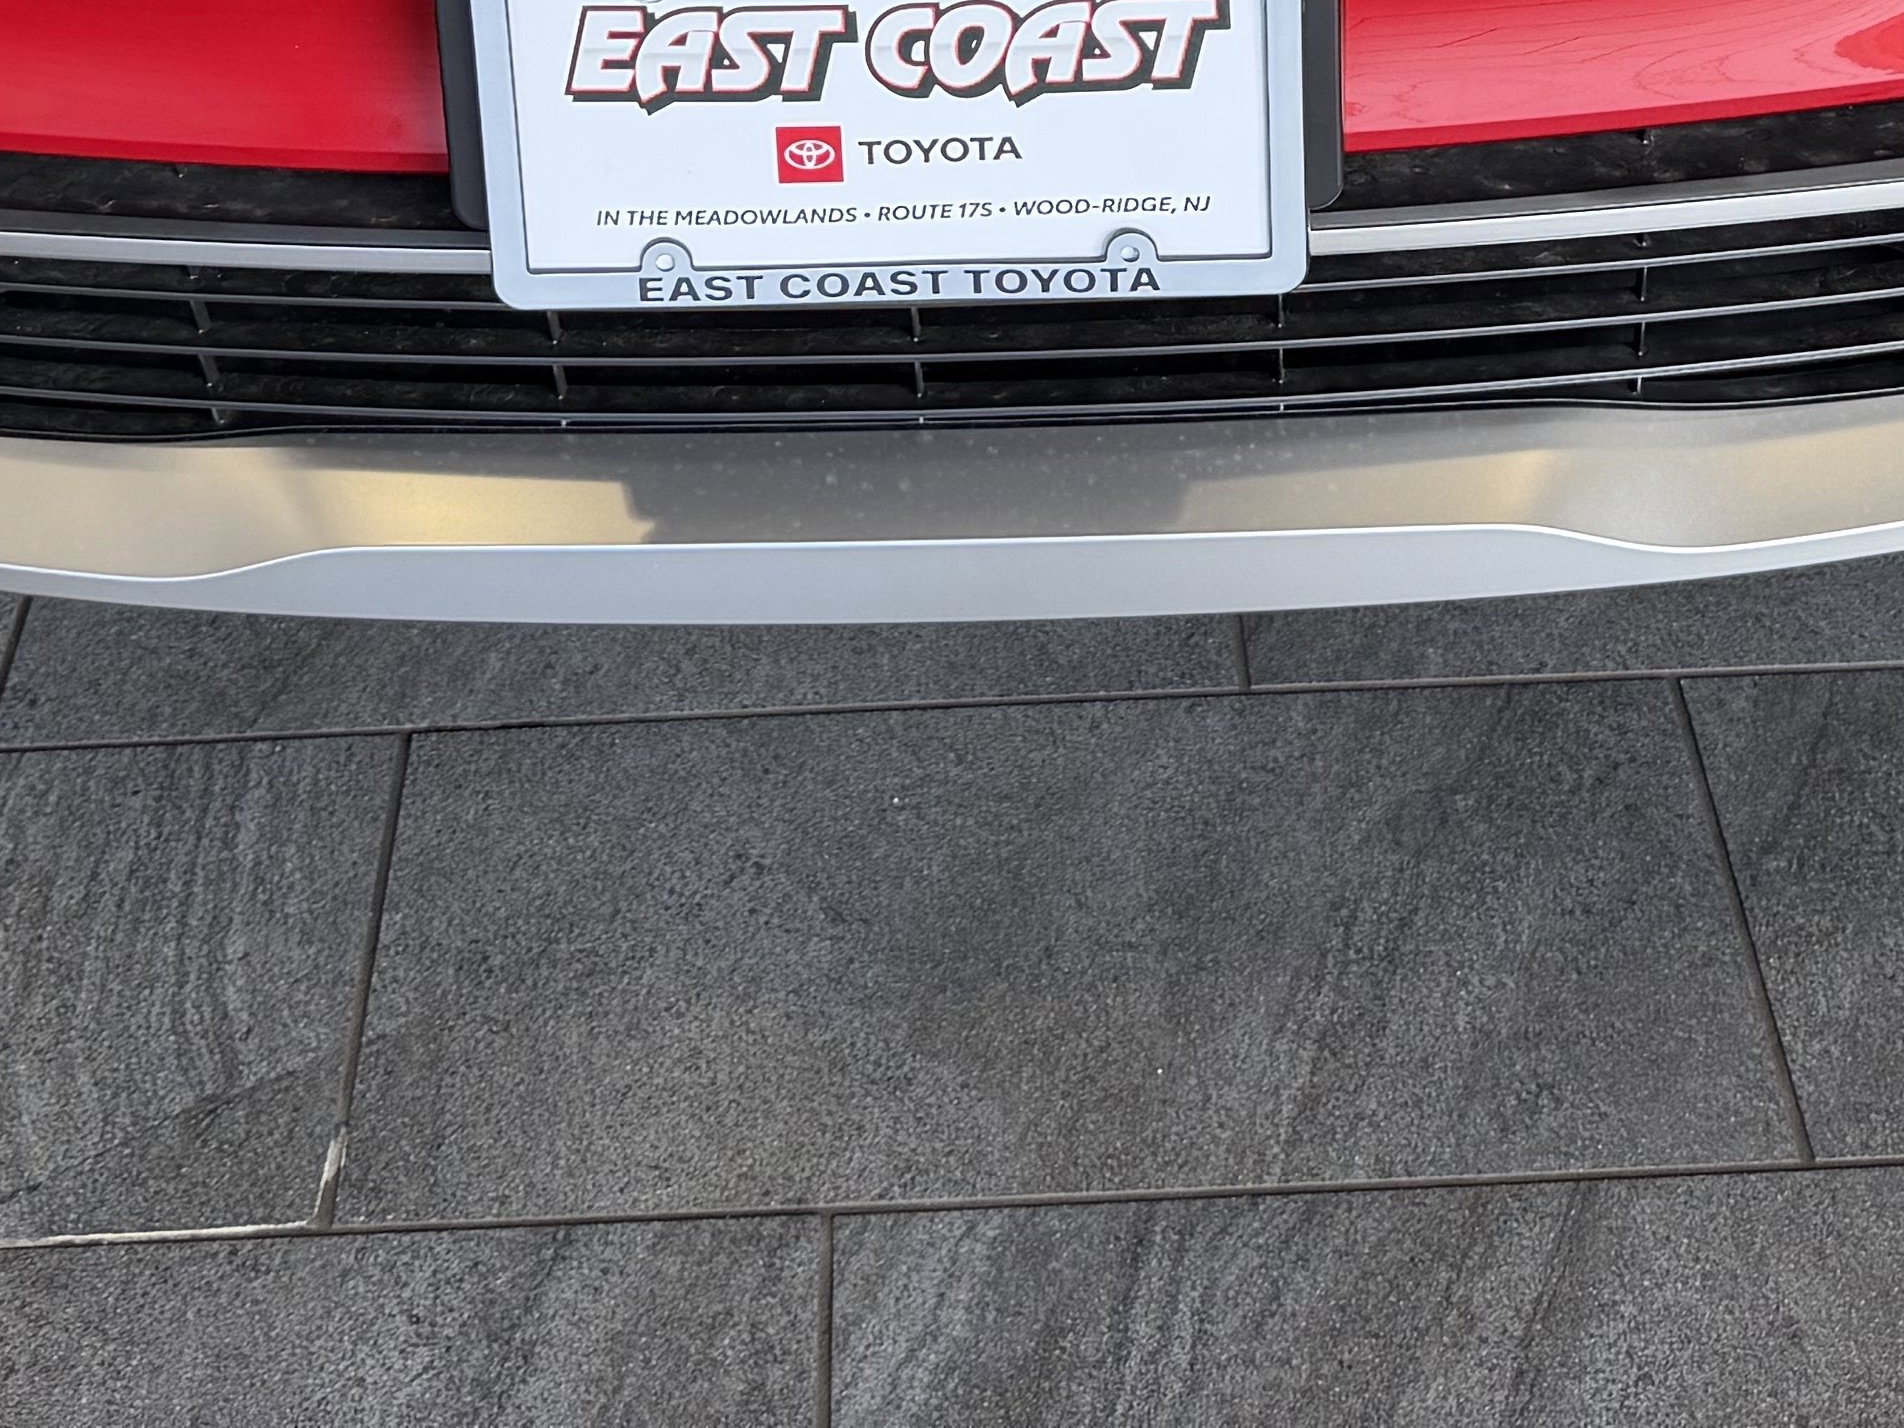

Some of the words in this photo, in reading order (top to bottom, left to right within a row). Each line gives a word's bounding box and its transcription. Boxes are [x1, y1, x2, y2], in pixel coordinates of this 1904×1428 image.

[564, 4, 859, 116] EAST
[857, 136, 1023, 165] TOYOTA
[596, 210, 621, 226] IN
[627, 210, 668, 226] THE
[673, 207, 858, 226] MEADOWLANDS
[877, 203, 953, 221] ROUTE
[959, 201, 993, 219] 17S
[1014, 196, 1177, 217] WOOD-RIDGE,
[1183, 196, 1211, 213] NJ
[638, 274, 764, 302] EAST
[779, 270, 949, 299] COAST
[963, 267, 1161, 296] TOYOTA
